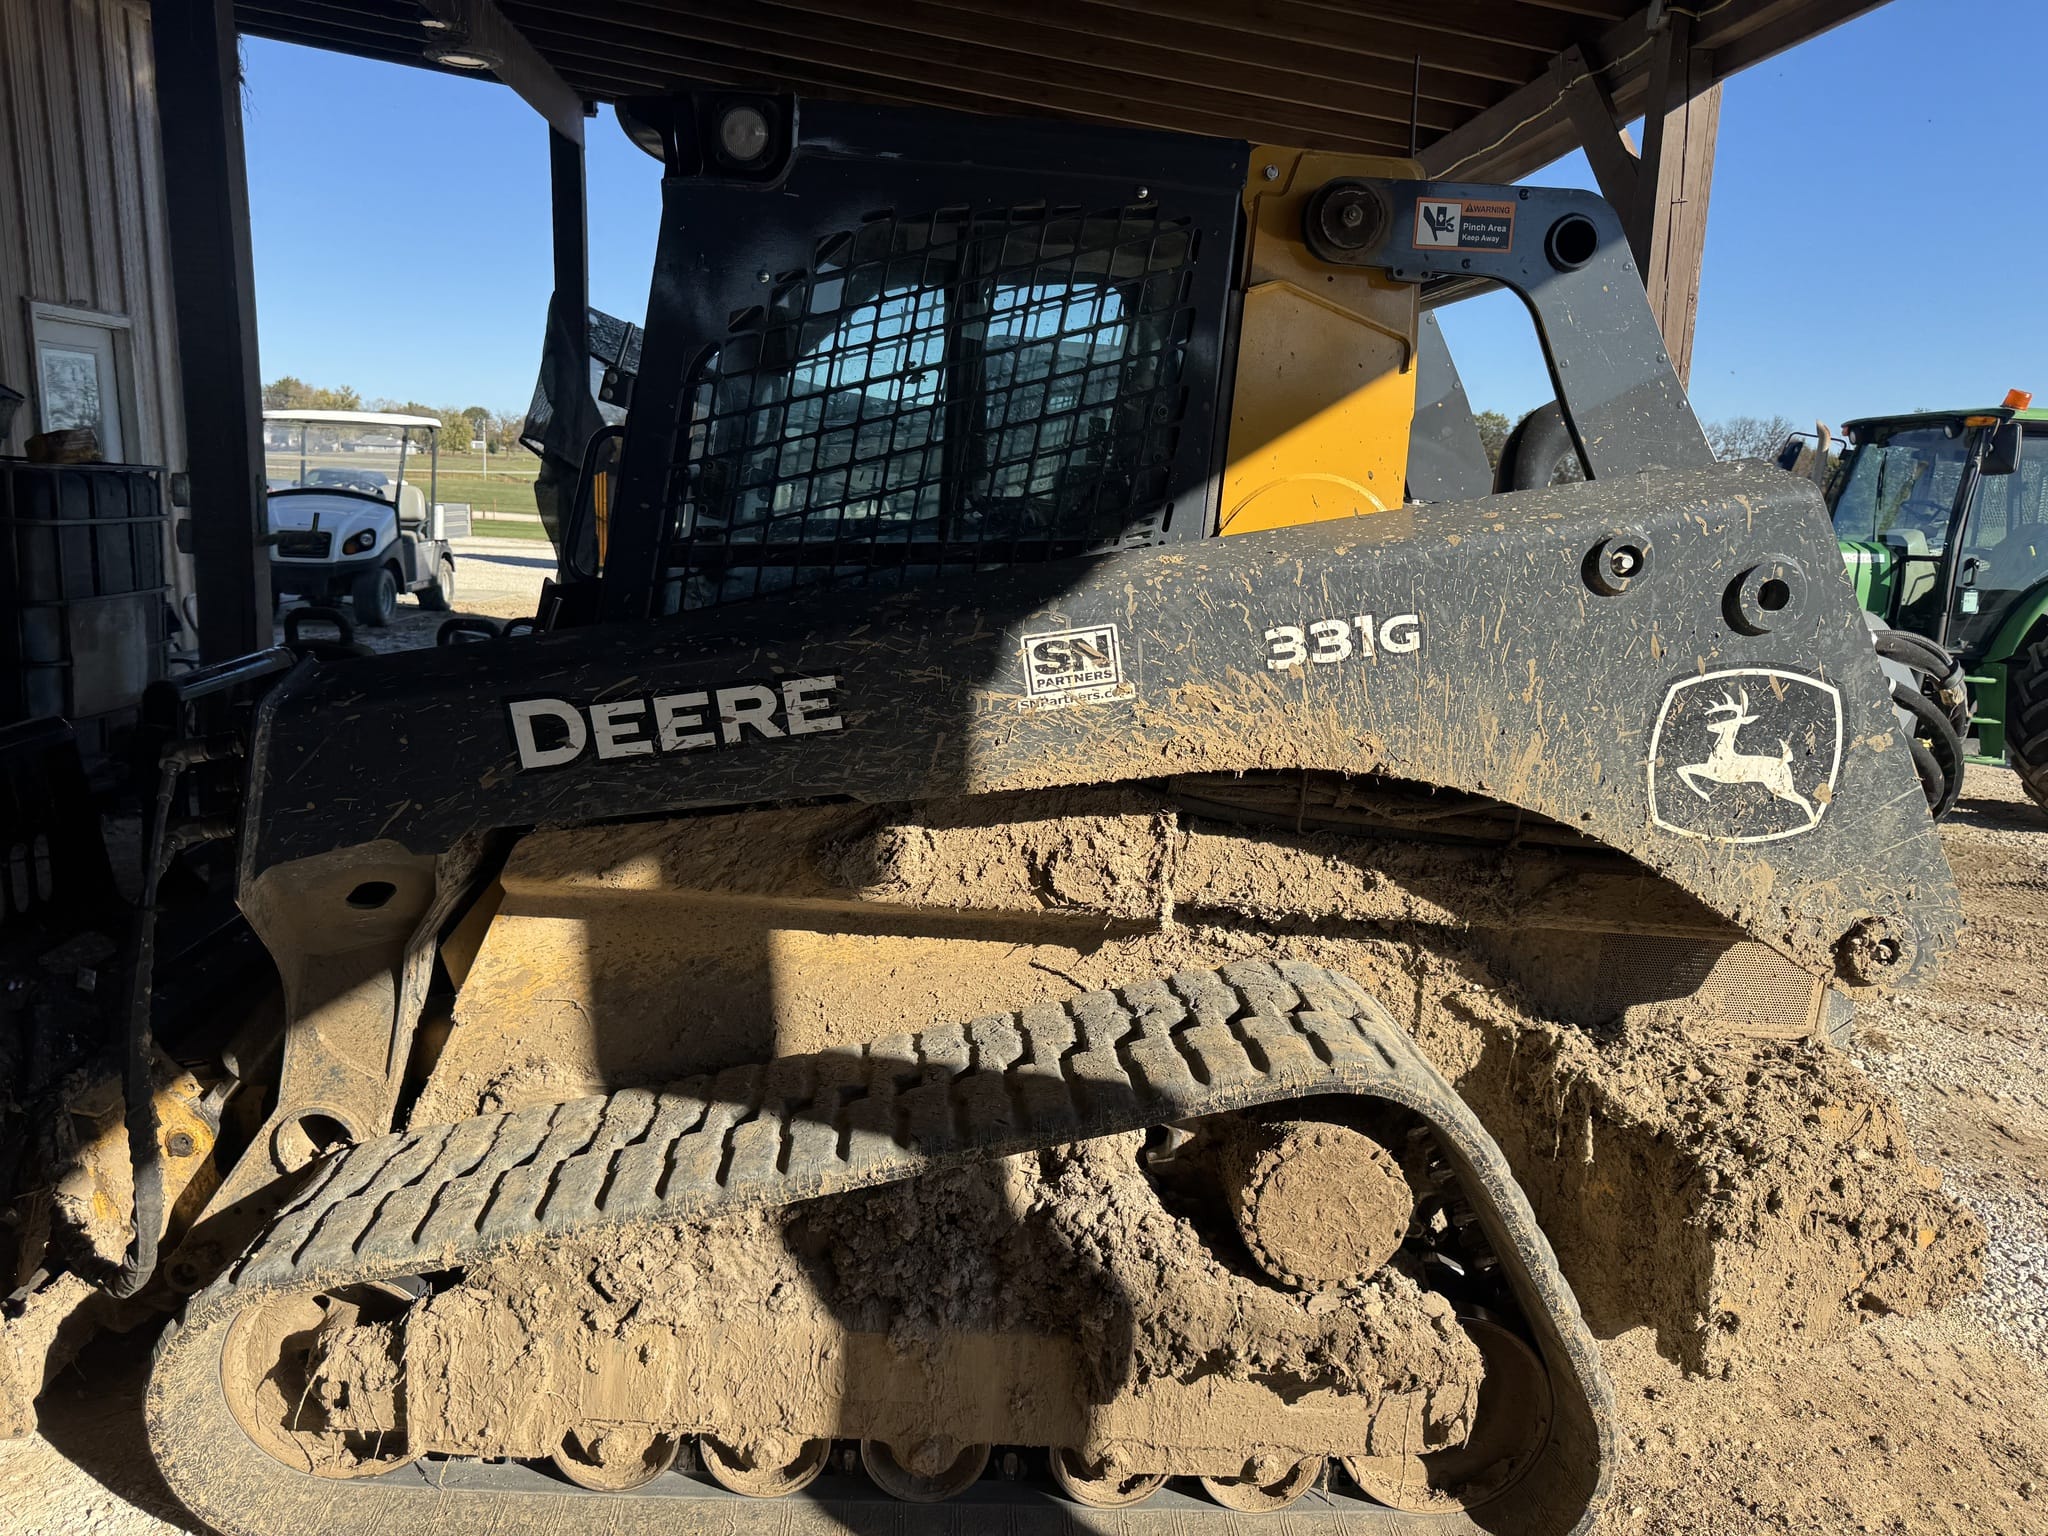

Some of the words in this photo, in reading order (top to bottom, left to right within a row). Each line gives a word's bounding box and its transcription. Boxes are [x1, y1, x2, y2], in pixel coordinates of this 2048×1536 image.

[1473, 207, 1511, 215] WARNING
[1463, 223, 1486, 232] Pinch
[1488, 224, 1507, 233] Area
[1462, 234, 1480, 242] Keep
[1481, 235, 1500, 243] Away
[1264, 614, 1420, 668] 331G
[1033, 634, 1111, 675] SN
[1037, 670, 1112, 688] PARTNERS
[1020, 690, 1132, 709] SNParters.c
[509, 675, 843, 769] DEERE
